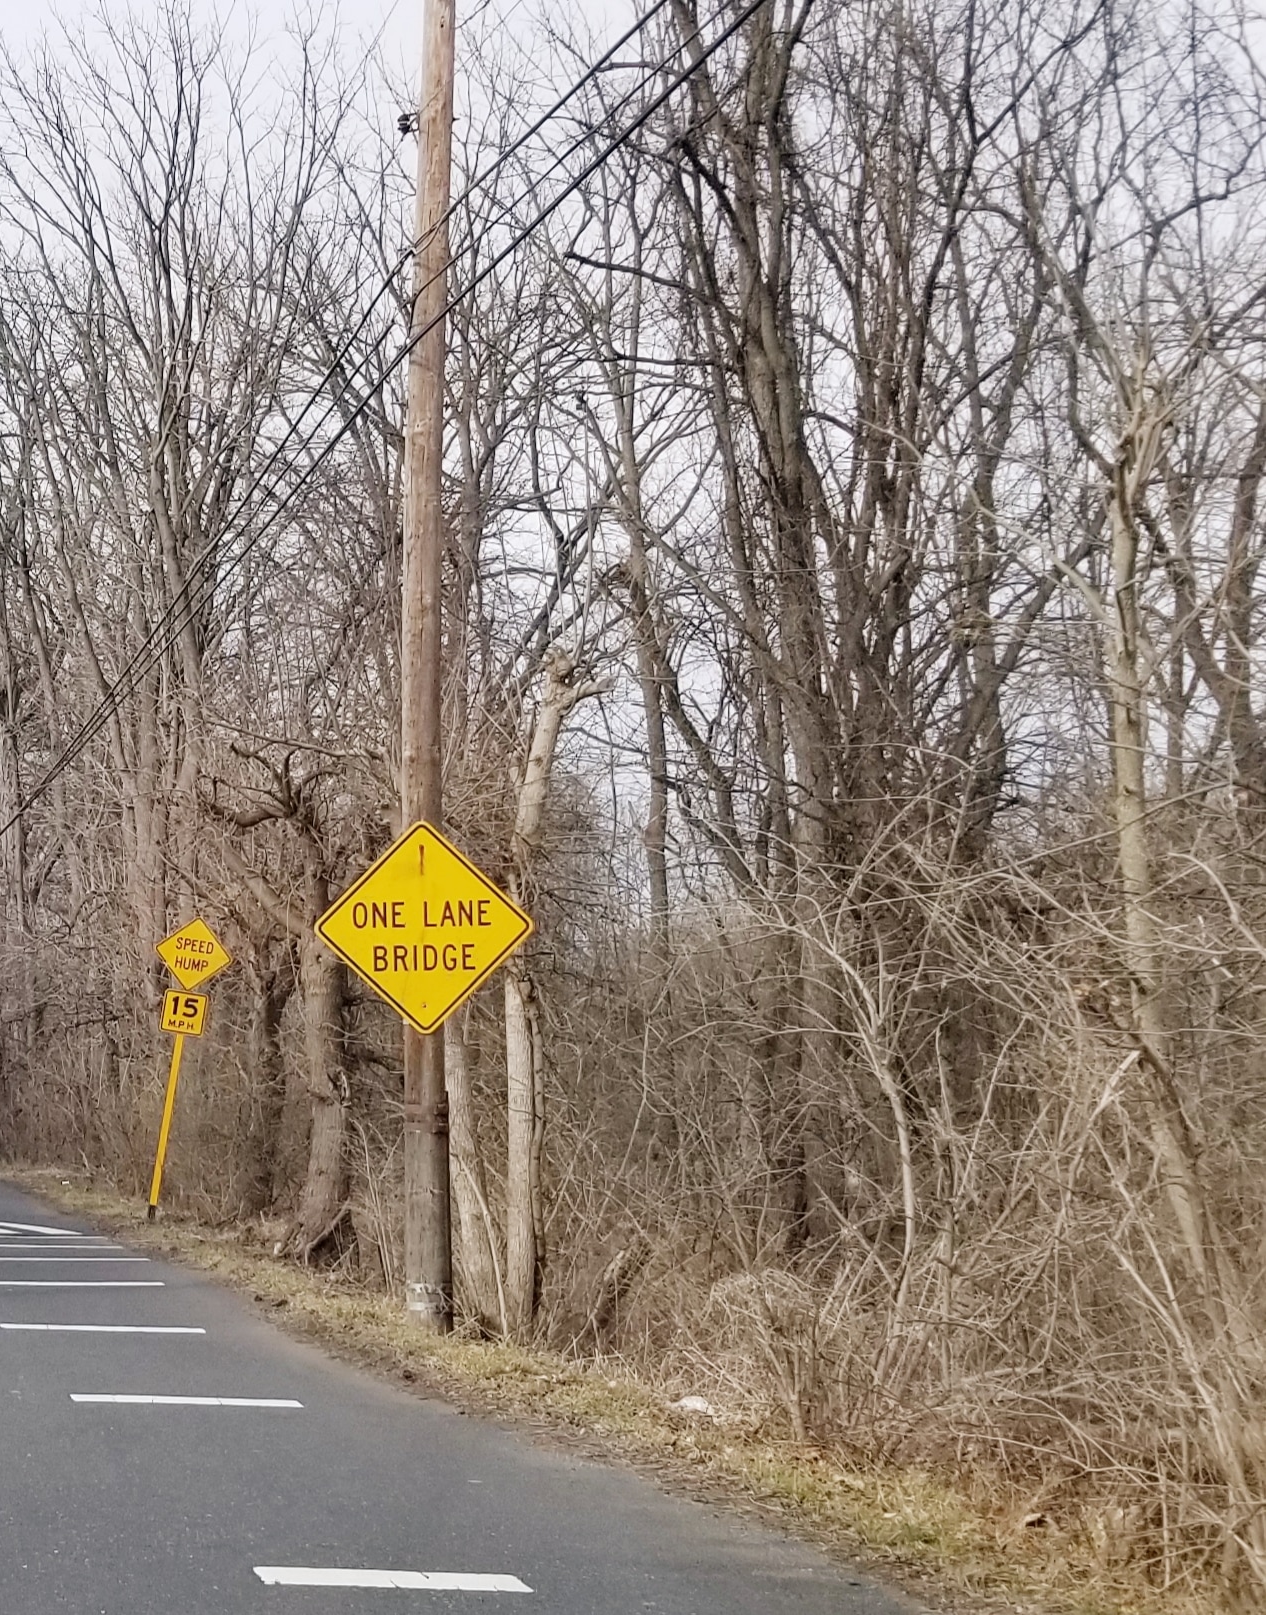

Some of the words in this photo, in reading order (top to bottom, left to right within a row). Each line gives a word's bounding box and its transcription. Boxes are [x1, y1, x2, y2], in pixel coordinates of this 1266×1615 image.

[352, 902, 406, 928] ONE
[423, 900, 492, 927] LANE
[175, 937, 214, 954] SPEED
[175, 956, 209, 972] HUMP
[372, 944, 476, 972] BRIDGE
[172, 996, 199, 1018] 15
